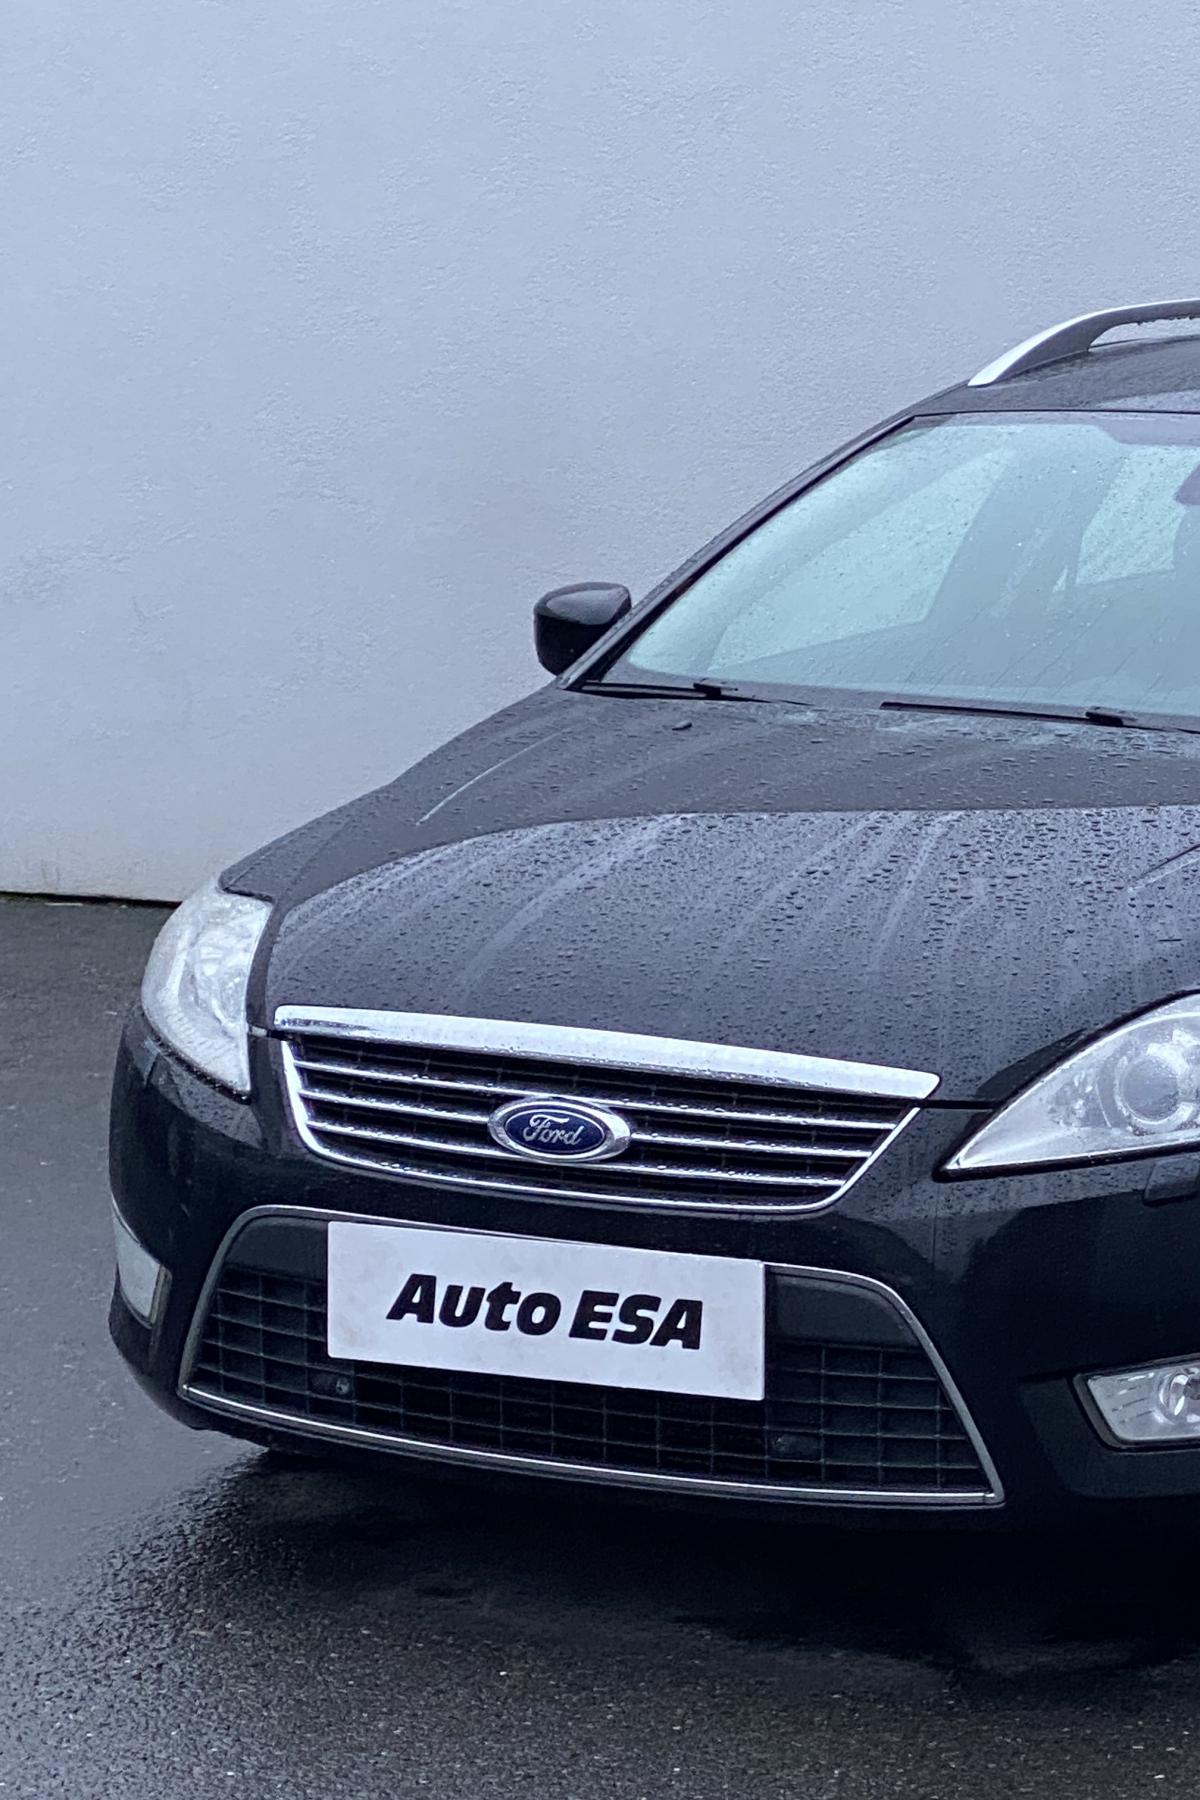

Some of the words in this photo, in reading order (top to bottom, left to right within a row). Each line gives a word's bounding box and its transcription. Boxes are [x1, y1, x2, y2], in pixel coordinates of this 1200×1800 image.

[522, 1114, 585, 1146] Ford
[386, 1273, 562, 1336] Auto
[568, 1290, 703, 1350] ESA
